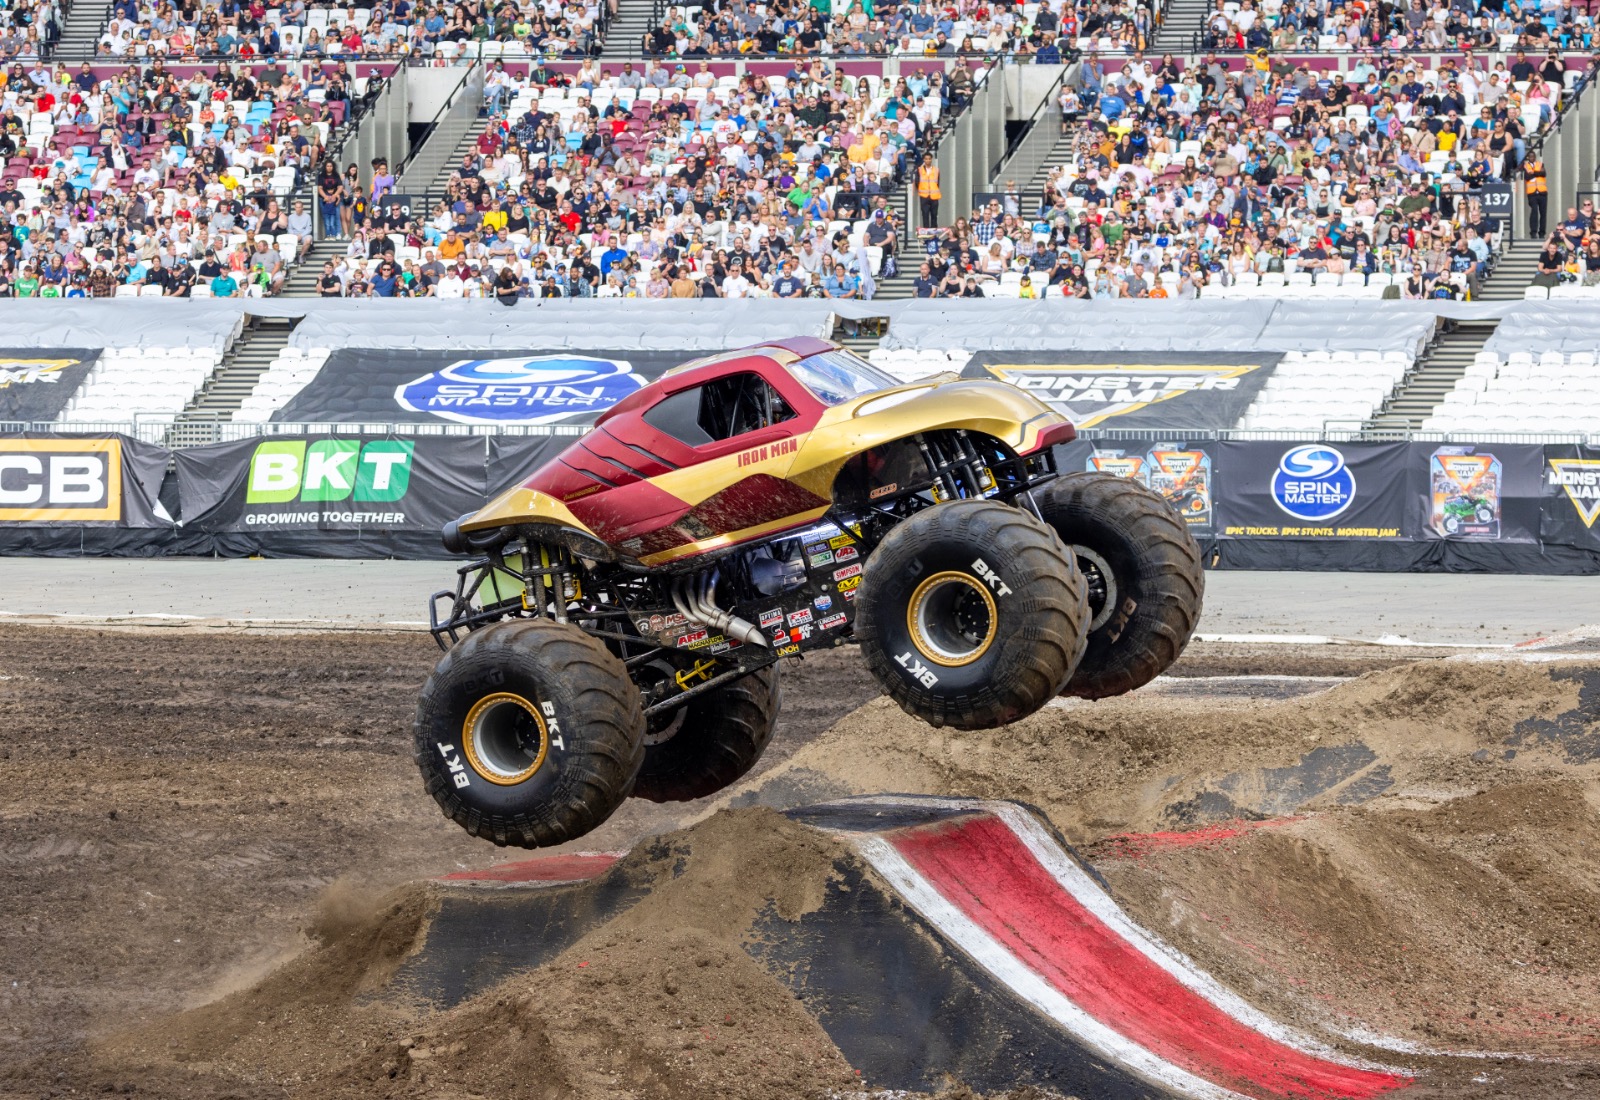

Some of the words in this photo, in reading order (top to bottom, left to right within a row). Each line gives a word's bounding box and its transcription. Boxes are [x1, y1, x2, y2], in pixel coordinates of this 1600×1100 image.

[1484, 193, 1510, 206] 137
[385, 205, 410, 217] 19
[436, 385, 605, 399] SPIN
[1037, 389, 1156, 402] JAM
[428, 397, 594, 406] MASTER
[737, 446, 768, 468] IRON
[771, 438, 798, 459] MAN
[252, 451, 408, 492] BKT
[0, 455, 104, 504] CB
[1284, 481, 1341, 494] SPIN
[1284, 493, 1341, 504] MASTER
[245, 512, 320, 525] GROWING
[322, 511, 405, 524] TOGETHER
[1225, 526, 1244, 535] EPIC
[1245, 527, 1279, 536] TRUCKS.
[1281, 528, 1301, 536] EPIC
[1301, 528, 1335, 537] STUNTS.
[1336, 528, 1378, 537] MONSTER
[836, 547, 856, 558] JAZ
[835, 565, 860, 579] SIMPSON
[970, 557, 1013, 598] BKT
[1107, 596, 1138, 645] BKT
[678, 630, 707, 646] ARP
[776, 644, 800, 657] UNOH
[893, 651, 939, 690] BKT
[540, 700, 565, 751] BKT
[437, 742, 471, 790] BKT
